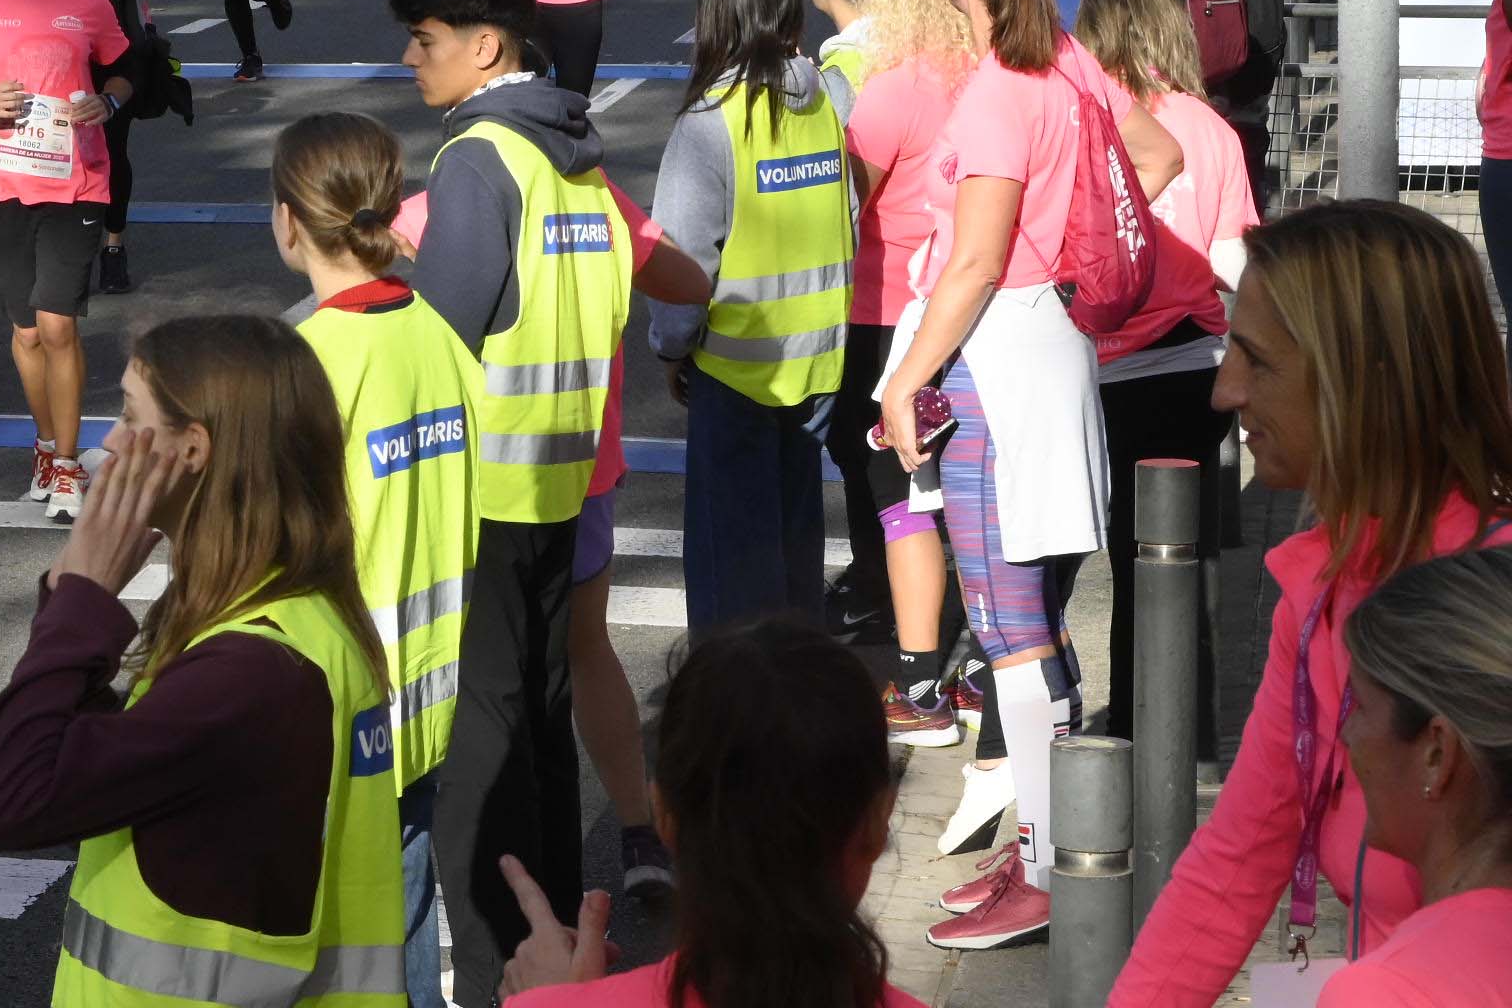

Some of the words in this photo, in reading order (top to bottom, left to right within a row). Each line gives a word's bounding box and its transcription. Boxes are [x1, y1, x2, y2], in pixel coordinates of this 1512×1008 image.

[17, 124, 45, 139] 016
[18, 138, 41, 150] 18062
[759, 157, 841, 185] VOLUNTARIS
